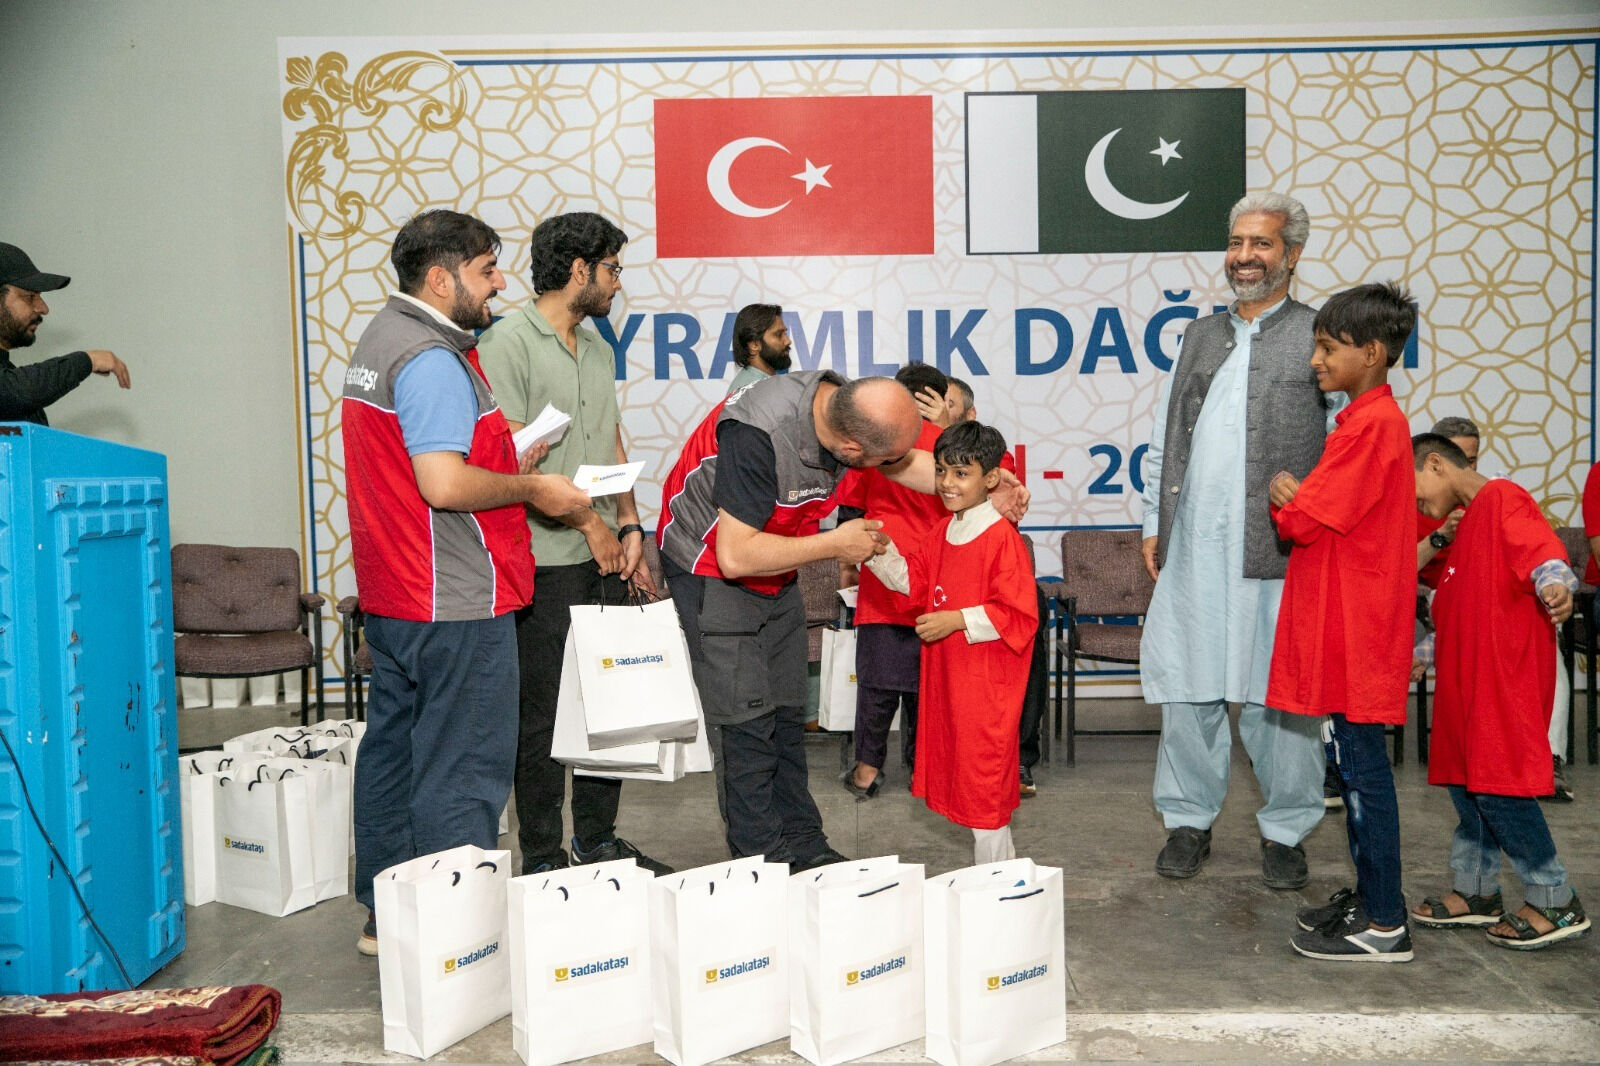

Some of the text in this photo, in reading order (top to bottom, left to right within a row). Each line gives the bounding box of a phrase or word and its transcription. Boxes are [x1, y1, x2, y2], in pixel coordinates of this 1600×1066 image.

[592, 289, 1418, 381] YRAMLIK DAĞI
[615, 654, 664, 666] sadakataşı
[457, 941, 499, 968] sadakataşı
[570, 956, 629, 978] sadakataşı
[719, 956, 770, 979] sadakataşı
[860, 956, 906, 981] sadakataşı
[1001, 964, 1048, 987] sadakataşı
